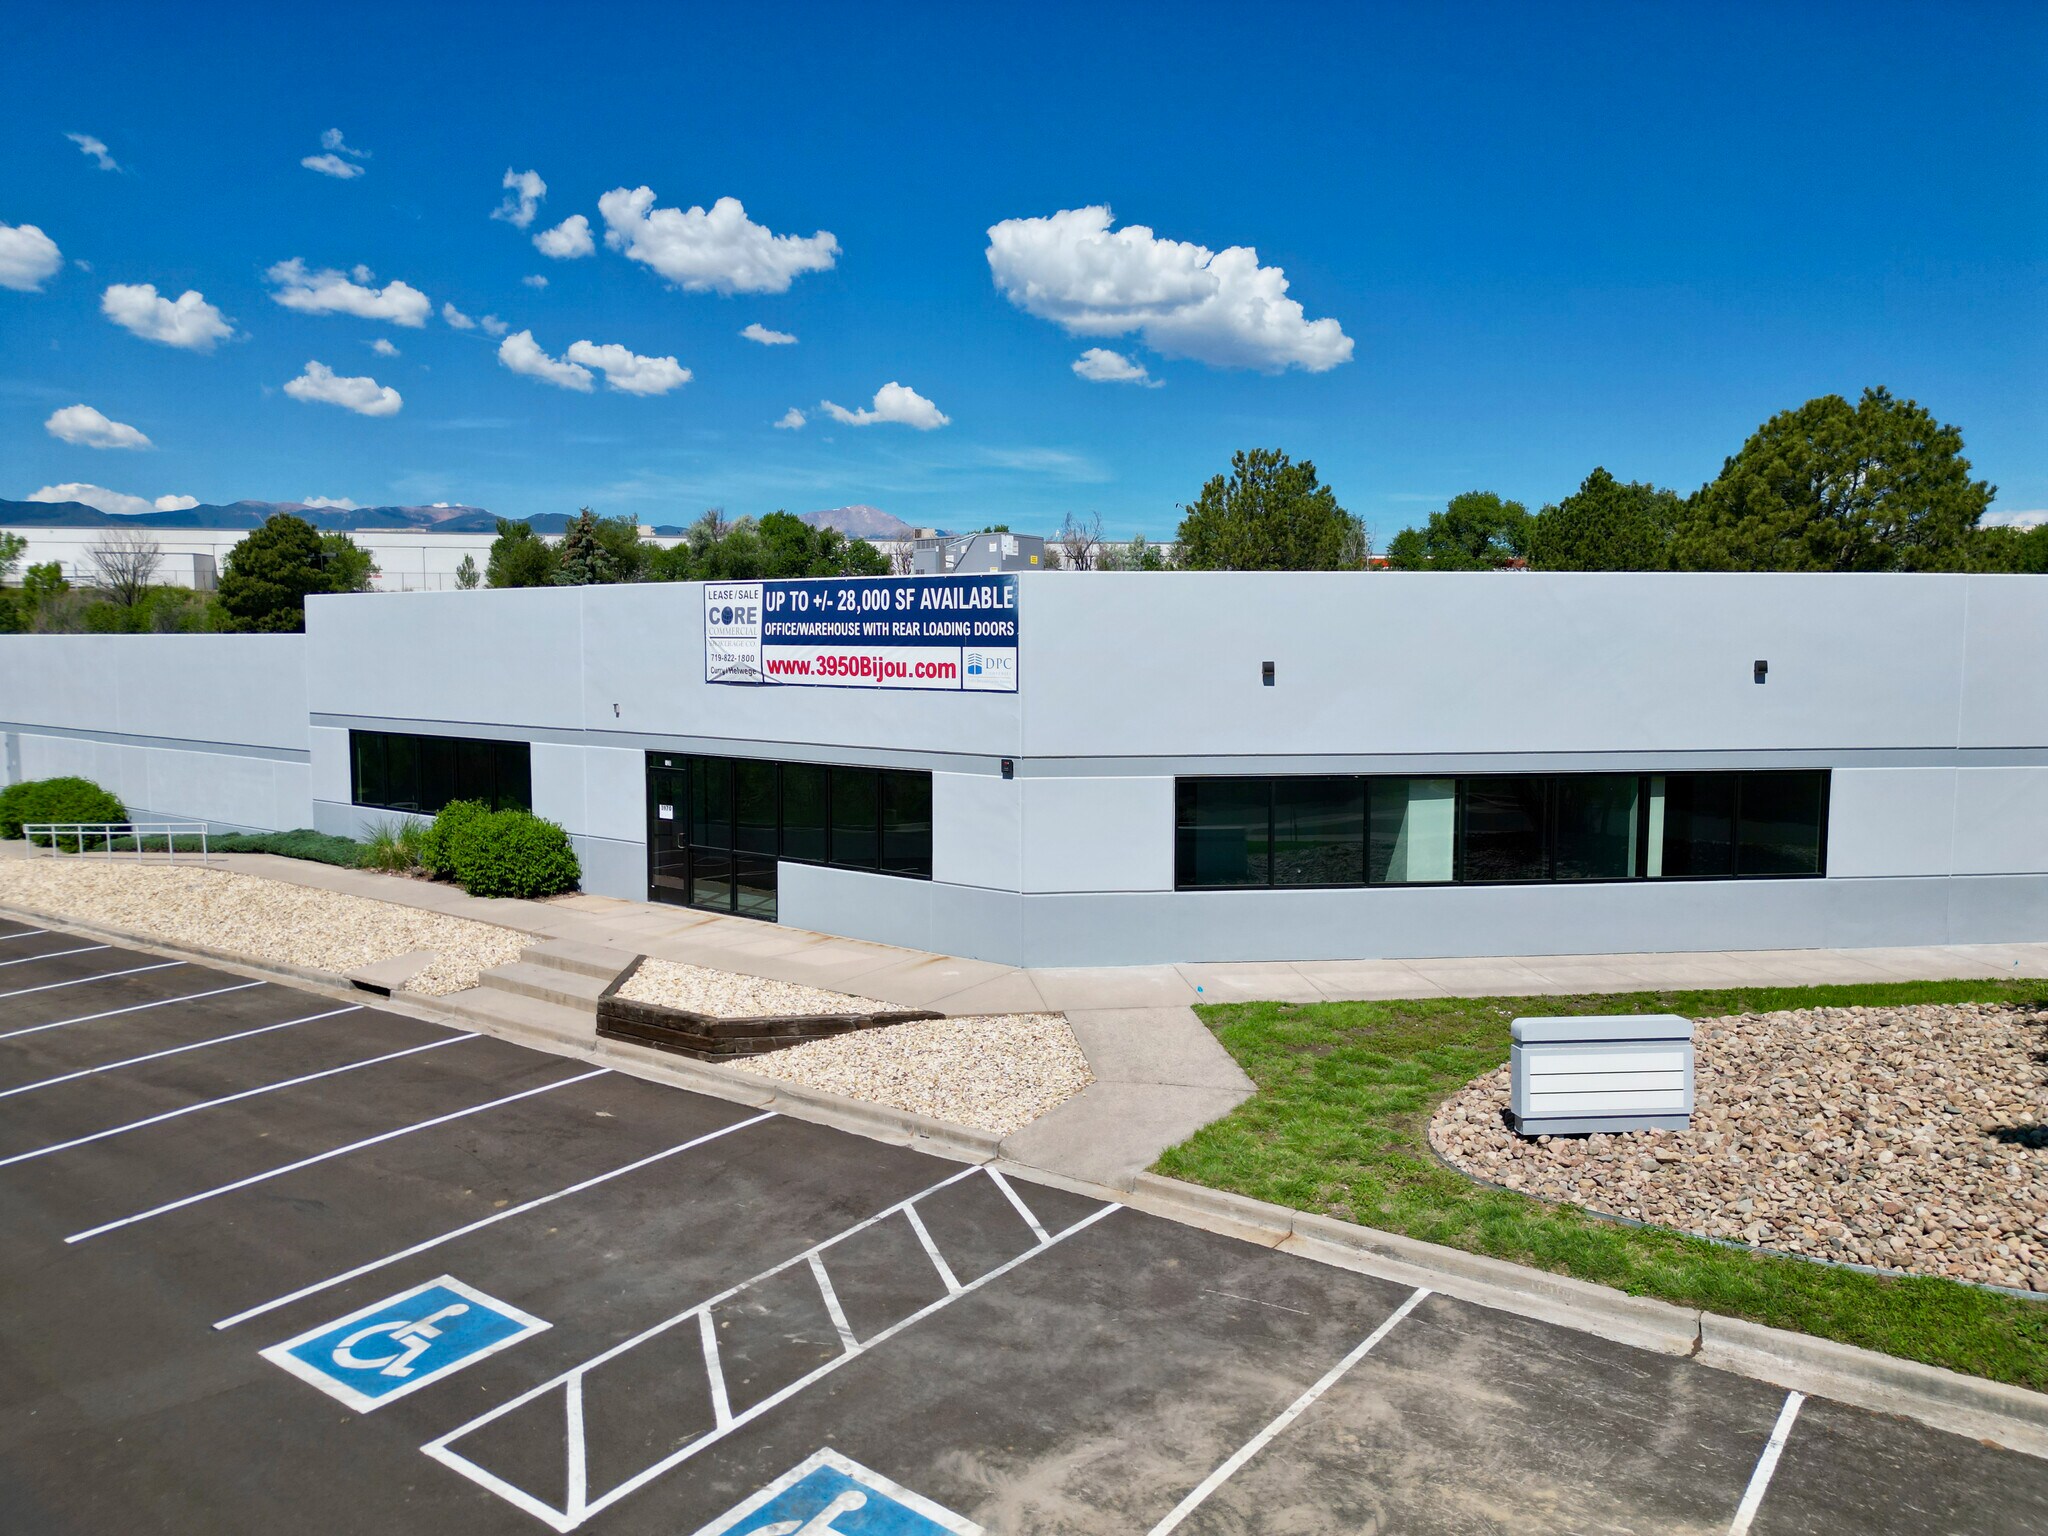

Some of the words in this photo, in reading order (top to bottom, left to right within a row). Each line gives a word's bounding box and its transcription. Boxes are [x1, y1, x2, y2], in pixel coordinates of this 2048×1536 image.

[766, 591, 786, 612] UP
[789, 590, 809, 612] TO
[813, 590, 834, 612] +/-
[837, 588, 890, 615] 28,000
[894, 588, 916, 611] SF
[919, 585, 1014, 610] AVAILABLE
[709, 606, 757, 625] CORE
[708, 626, 758, 636] COMMERCIAL
[764, 622, 861, 636] OFFICE/WAREHOUSE
[862, 622, 890, 637] WITH
[892, 621, 921, 637] REAR
[923, 621, 971, 637] LOADING
[974, 621, 1015, 637] DOORS
[711, 653, 755, 662] 719-822-1800
[985, 657, 1012, 670] DPC
[766, 655, 957, 683] www.3950Bijou.com
